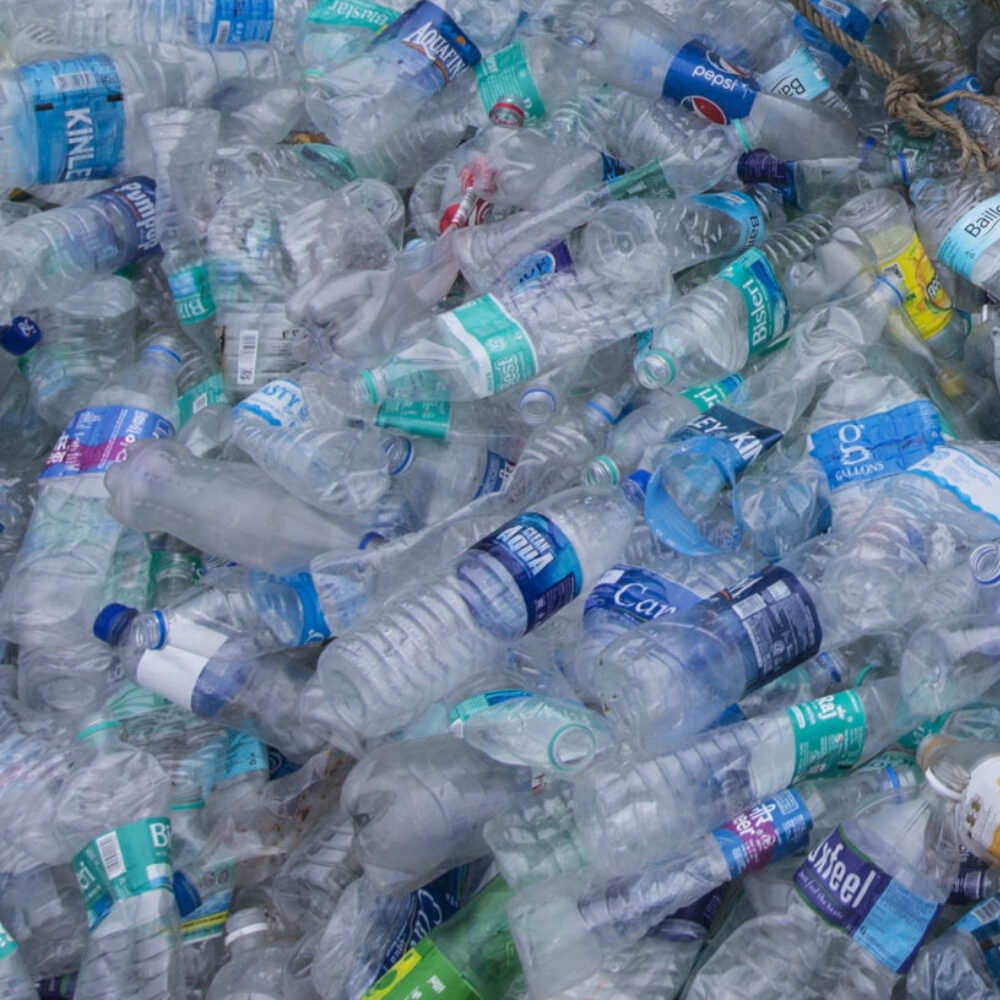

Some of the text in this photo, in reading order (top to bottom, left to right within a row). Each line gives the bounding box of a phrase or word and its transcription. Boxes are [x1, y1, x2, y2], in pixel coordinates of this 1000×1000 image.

[691, 64, 736, 90] pepsi
[743, 278, 770, 348] Bisleri
[834, 460, 885, 482] GALLONS
[522, 526, 554, 556] CLEAN
